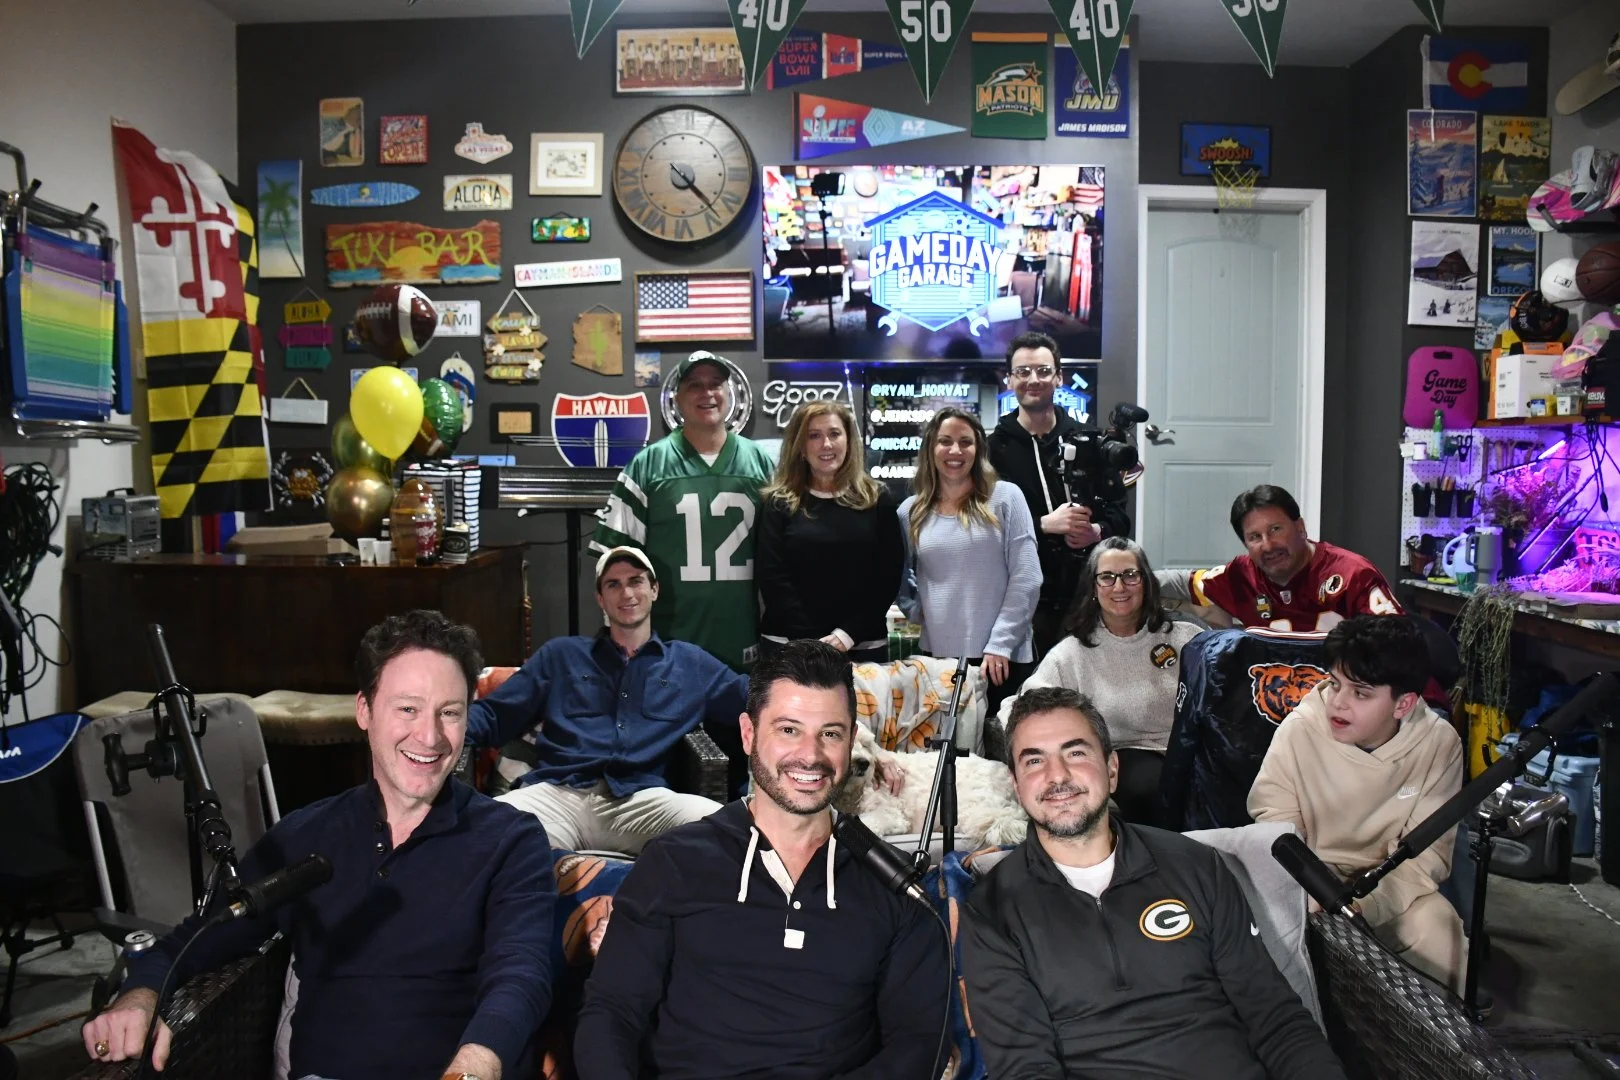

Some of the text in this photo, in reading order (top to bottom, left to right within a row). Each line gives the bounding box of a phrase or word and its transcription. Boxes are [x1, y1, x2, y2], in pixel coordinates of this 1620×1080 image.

[900, 0, 952, 42] 50
[1069, 0, 1121, 41] 40
[779, 42, 818, 53] SUPER
[779, 53, 818, 64] BOWL
[978, 84, 1041, 107] MASON
[1066, 93, 1119, 110] JMU
[1058, 123, 1127, 133] JAMES MADISON
[1422, 120, 1463, 129] COORADO
[415, 230, 497, 269] BAR
[869, 232, 1002, 278] GAMEDAY
[897, 263, 975, 289] GARAGE
[1491, 286, 1532, 295] OREGO
[441, 313, 472, 326] AMI
[870, 384, 970, 398] @RYAN_HORVAT
[1422, 369, 1468, 394] Game
[762, 380, 843, 414] Good
[1430, 389, 1457, 408] Day
[571, 400, 629, 416] HAWAII
[675, 491, 756, 582] 12
